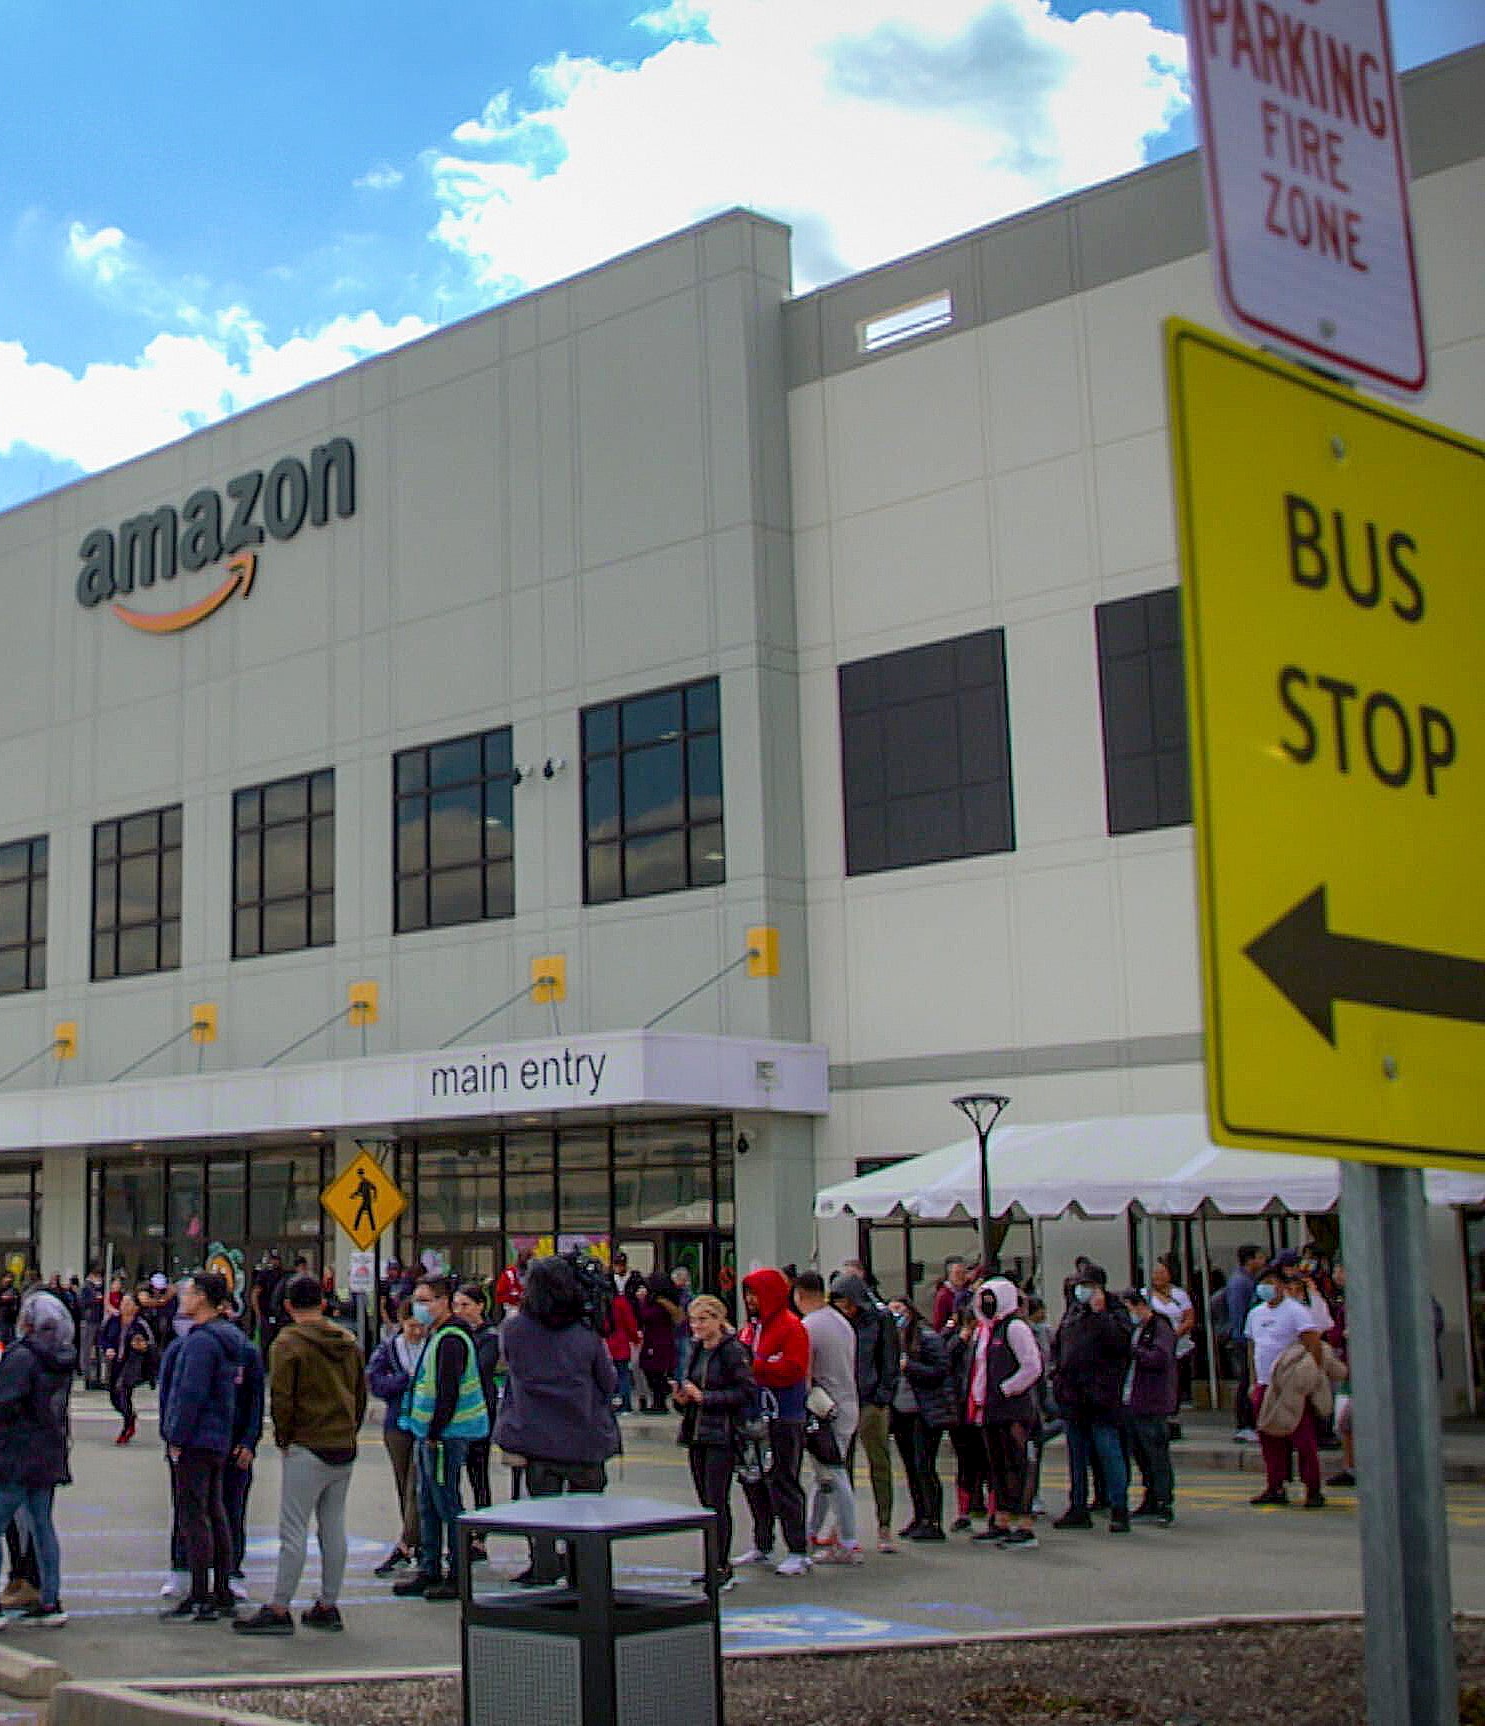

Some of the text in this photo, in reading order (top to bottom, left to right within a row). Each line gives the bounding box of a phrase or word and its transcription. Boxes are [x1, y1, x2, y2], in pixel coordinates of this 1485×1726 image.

[1205, 0, 1387, 139] PARKING
[1261, 100, 1351, 194] FIRE
[1261, 172, 1369, 273] ZONE
[76, 437, 356, 608] amazon
[1284, 493, 1425, 624] BUS
[1277, 664, 1457, 797] STOP
[432, 1048, 607, 1097] main entry
